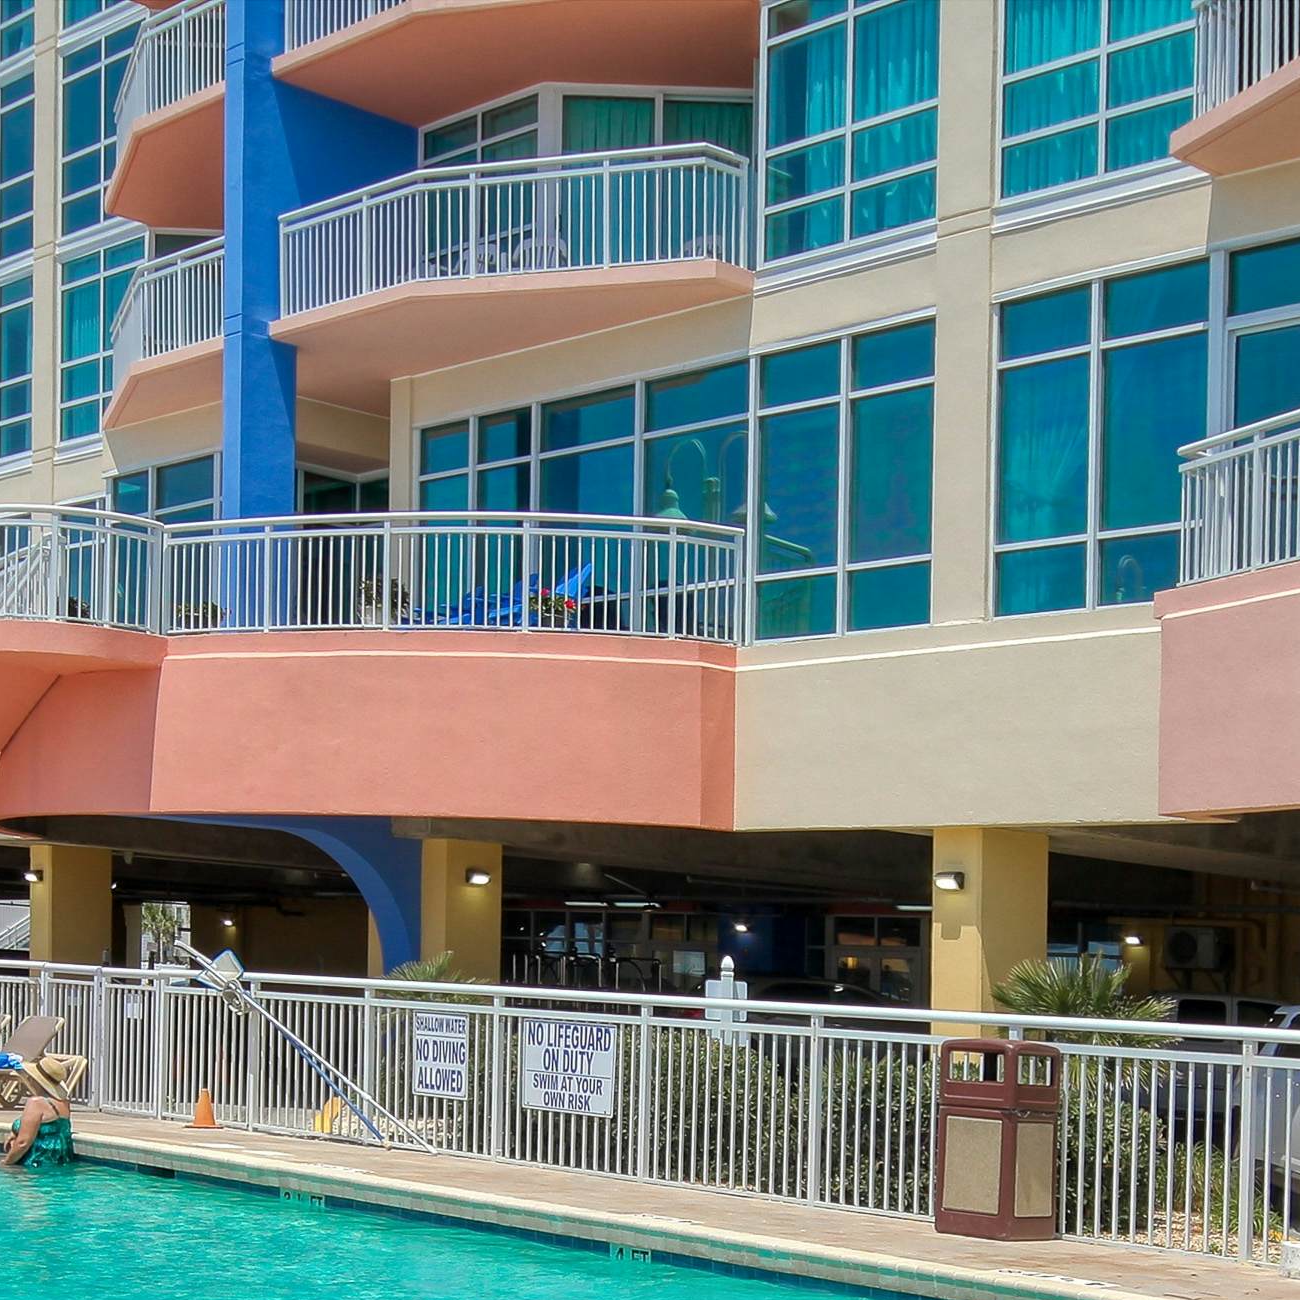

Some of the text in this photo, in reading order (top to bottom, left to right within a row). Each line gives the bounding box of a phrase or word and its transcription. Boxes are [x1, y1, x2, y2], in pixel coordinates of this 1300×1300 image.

[416, 1016, 466, 1034] SHALLOW WATER
[528, 1022, 611, 1052] NO LIFEGUARD
[416, 1038, 466, 1065] NO DIVING
[543, 1048, 594, 1076] ON DUTY
[417, 1066, 463, 1093] ALLOWED
[533, 1073, 603, 1096] SWIM AT YOUR
[543, 1091, 591, 1112] OWN RISK
